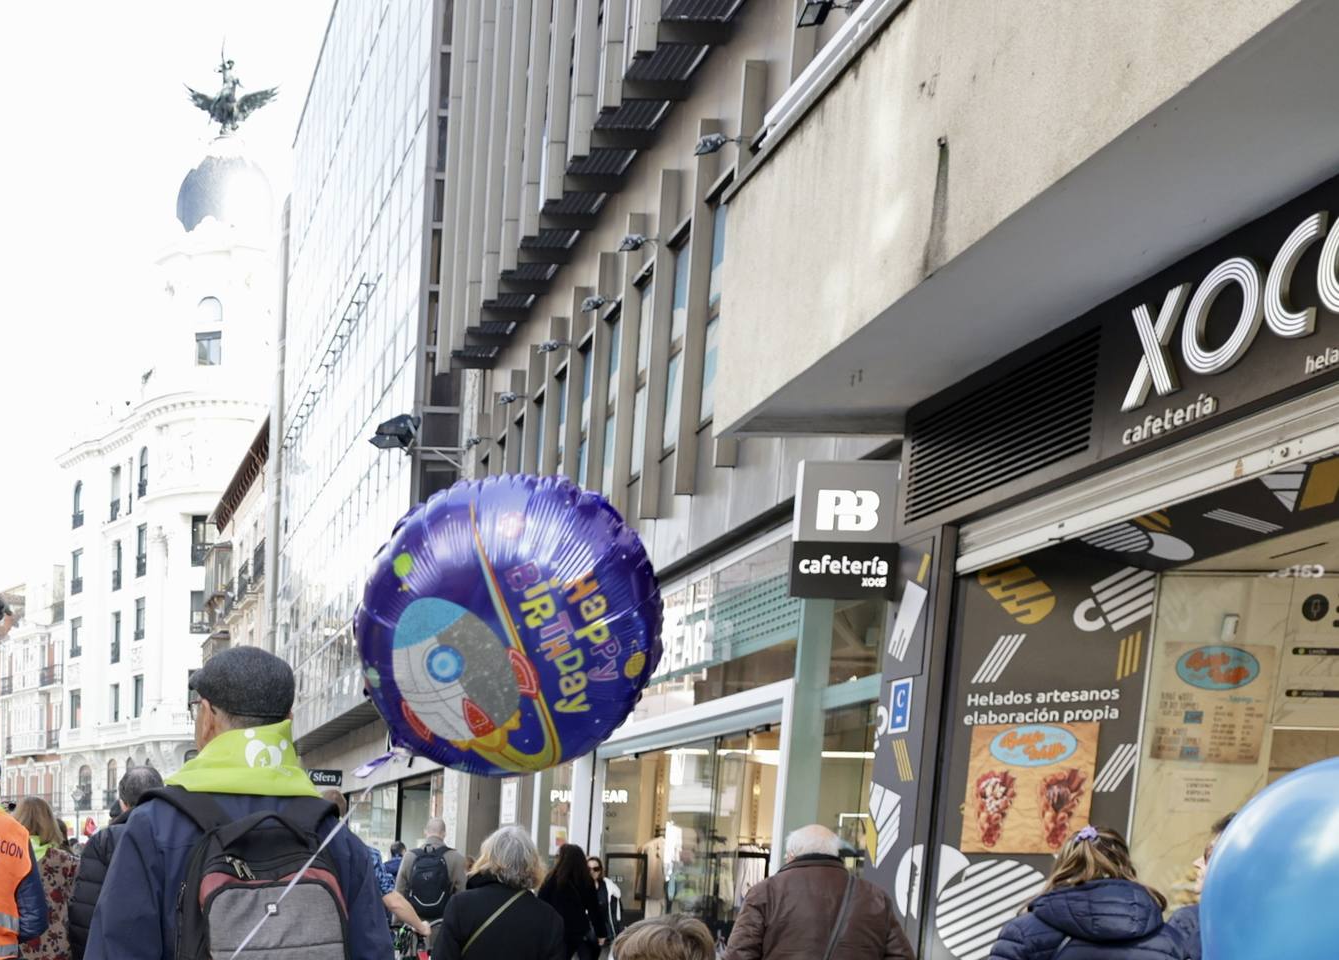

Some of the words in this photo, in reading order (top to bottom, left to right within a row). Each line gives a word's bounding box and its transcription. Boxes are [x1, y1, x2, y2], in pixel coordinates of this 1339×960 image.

[1121, 393, 1217, 446] cafetería
[798, 554, 889, 576] cafetería
[966, 691, 1032, 706] Helados
[1036, 688, 1120, 704] artesanos
[963, 708, 1059, 725] elaboración
[1063, 706, 1119, 723] propia
